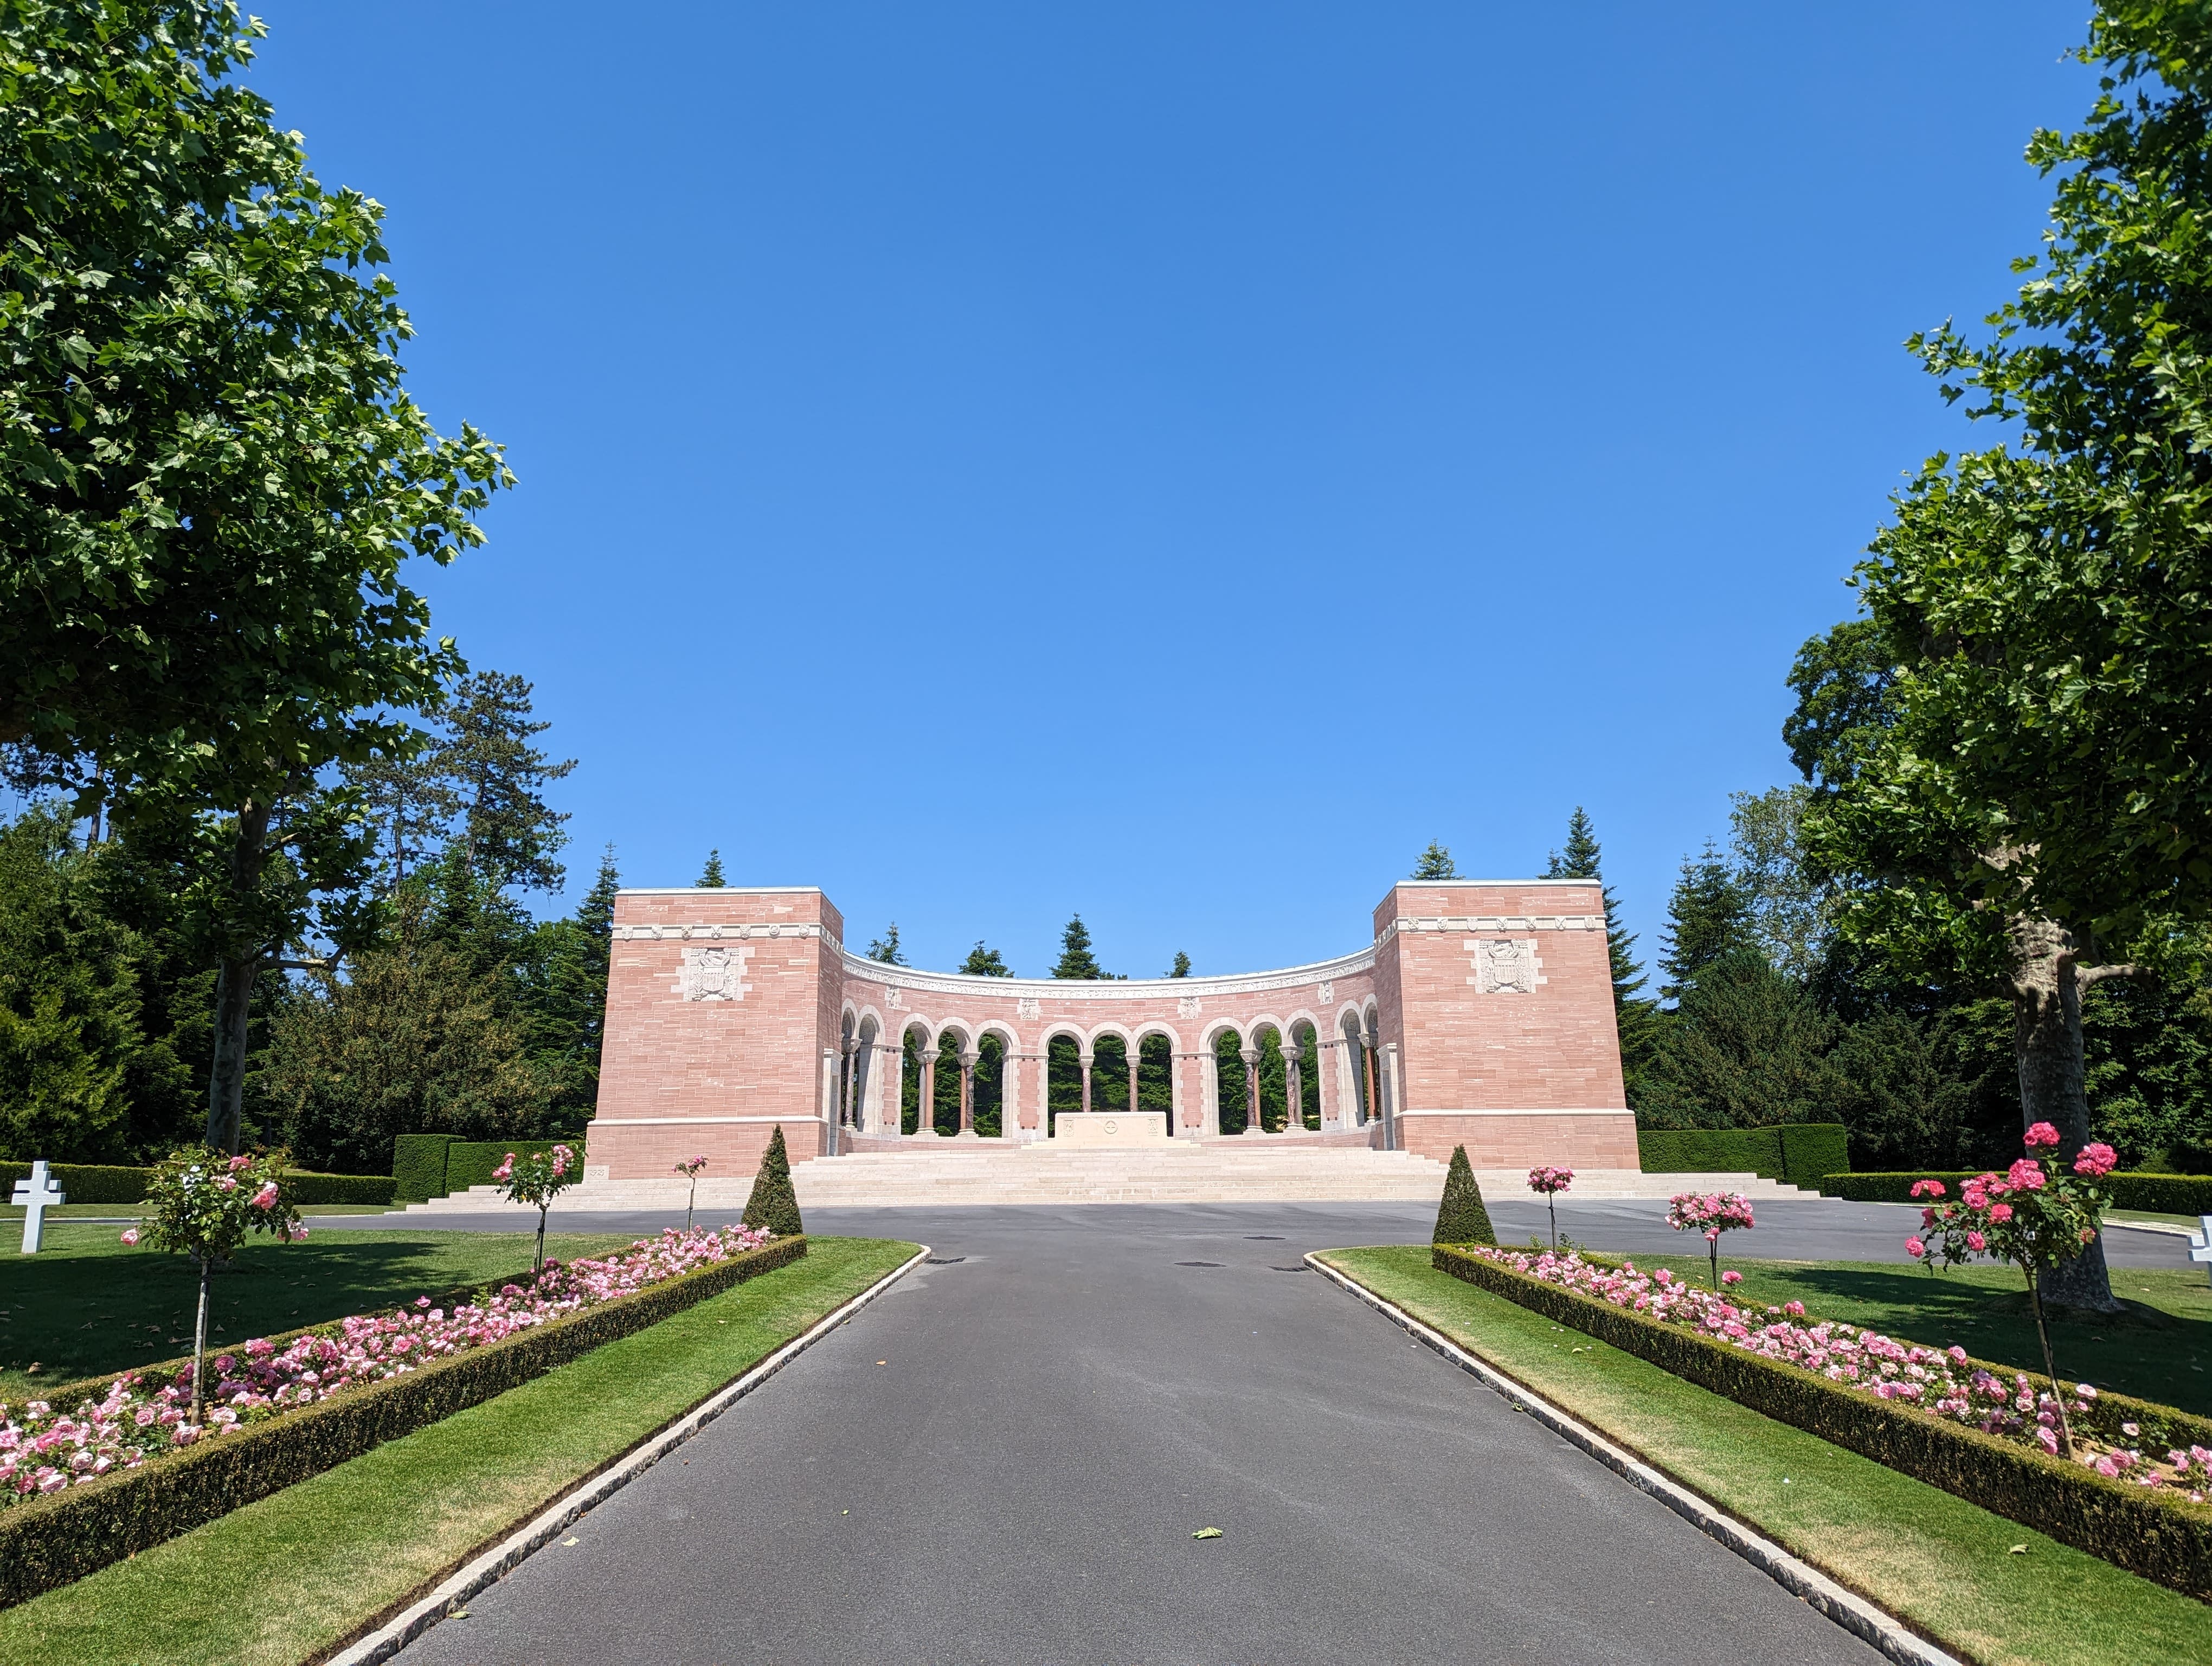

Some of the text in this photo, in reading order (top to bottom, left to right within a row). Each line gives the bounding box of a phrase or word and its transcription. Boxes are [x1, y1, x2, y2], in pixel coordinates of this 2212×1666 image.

[950, 984, 982, 995] HONOR
[987, 987, 1008, 996] AND
[1141, 990, 1164, 998] AND
[1168, 988, 1195, 997] THAT
[1198, 986, 1219, 996] THE
[1223, 983, 1256, 994] WORLD
[1290, 974, 1315, 985] ENJOY
